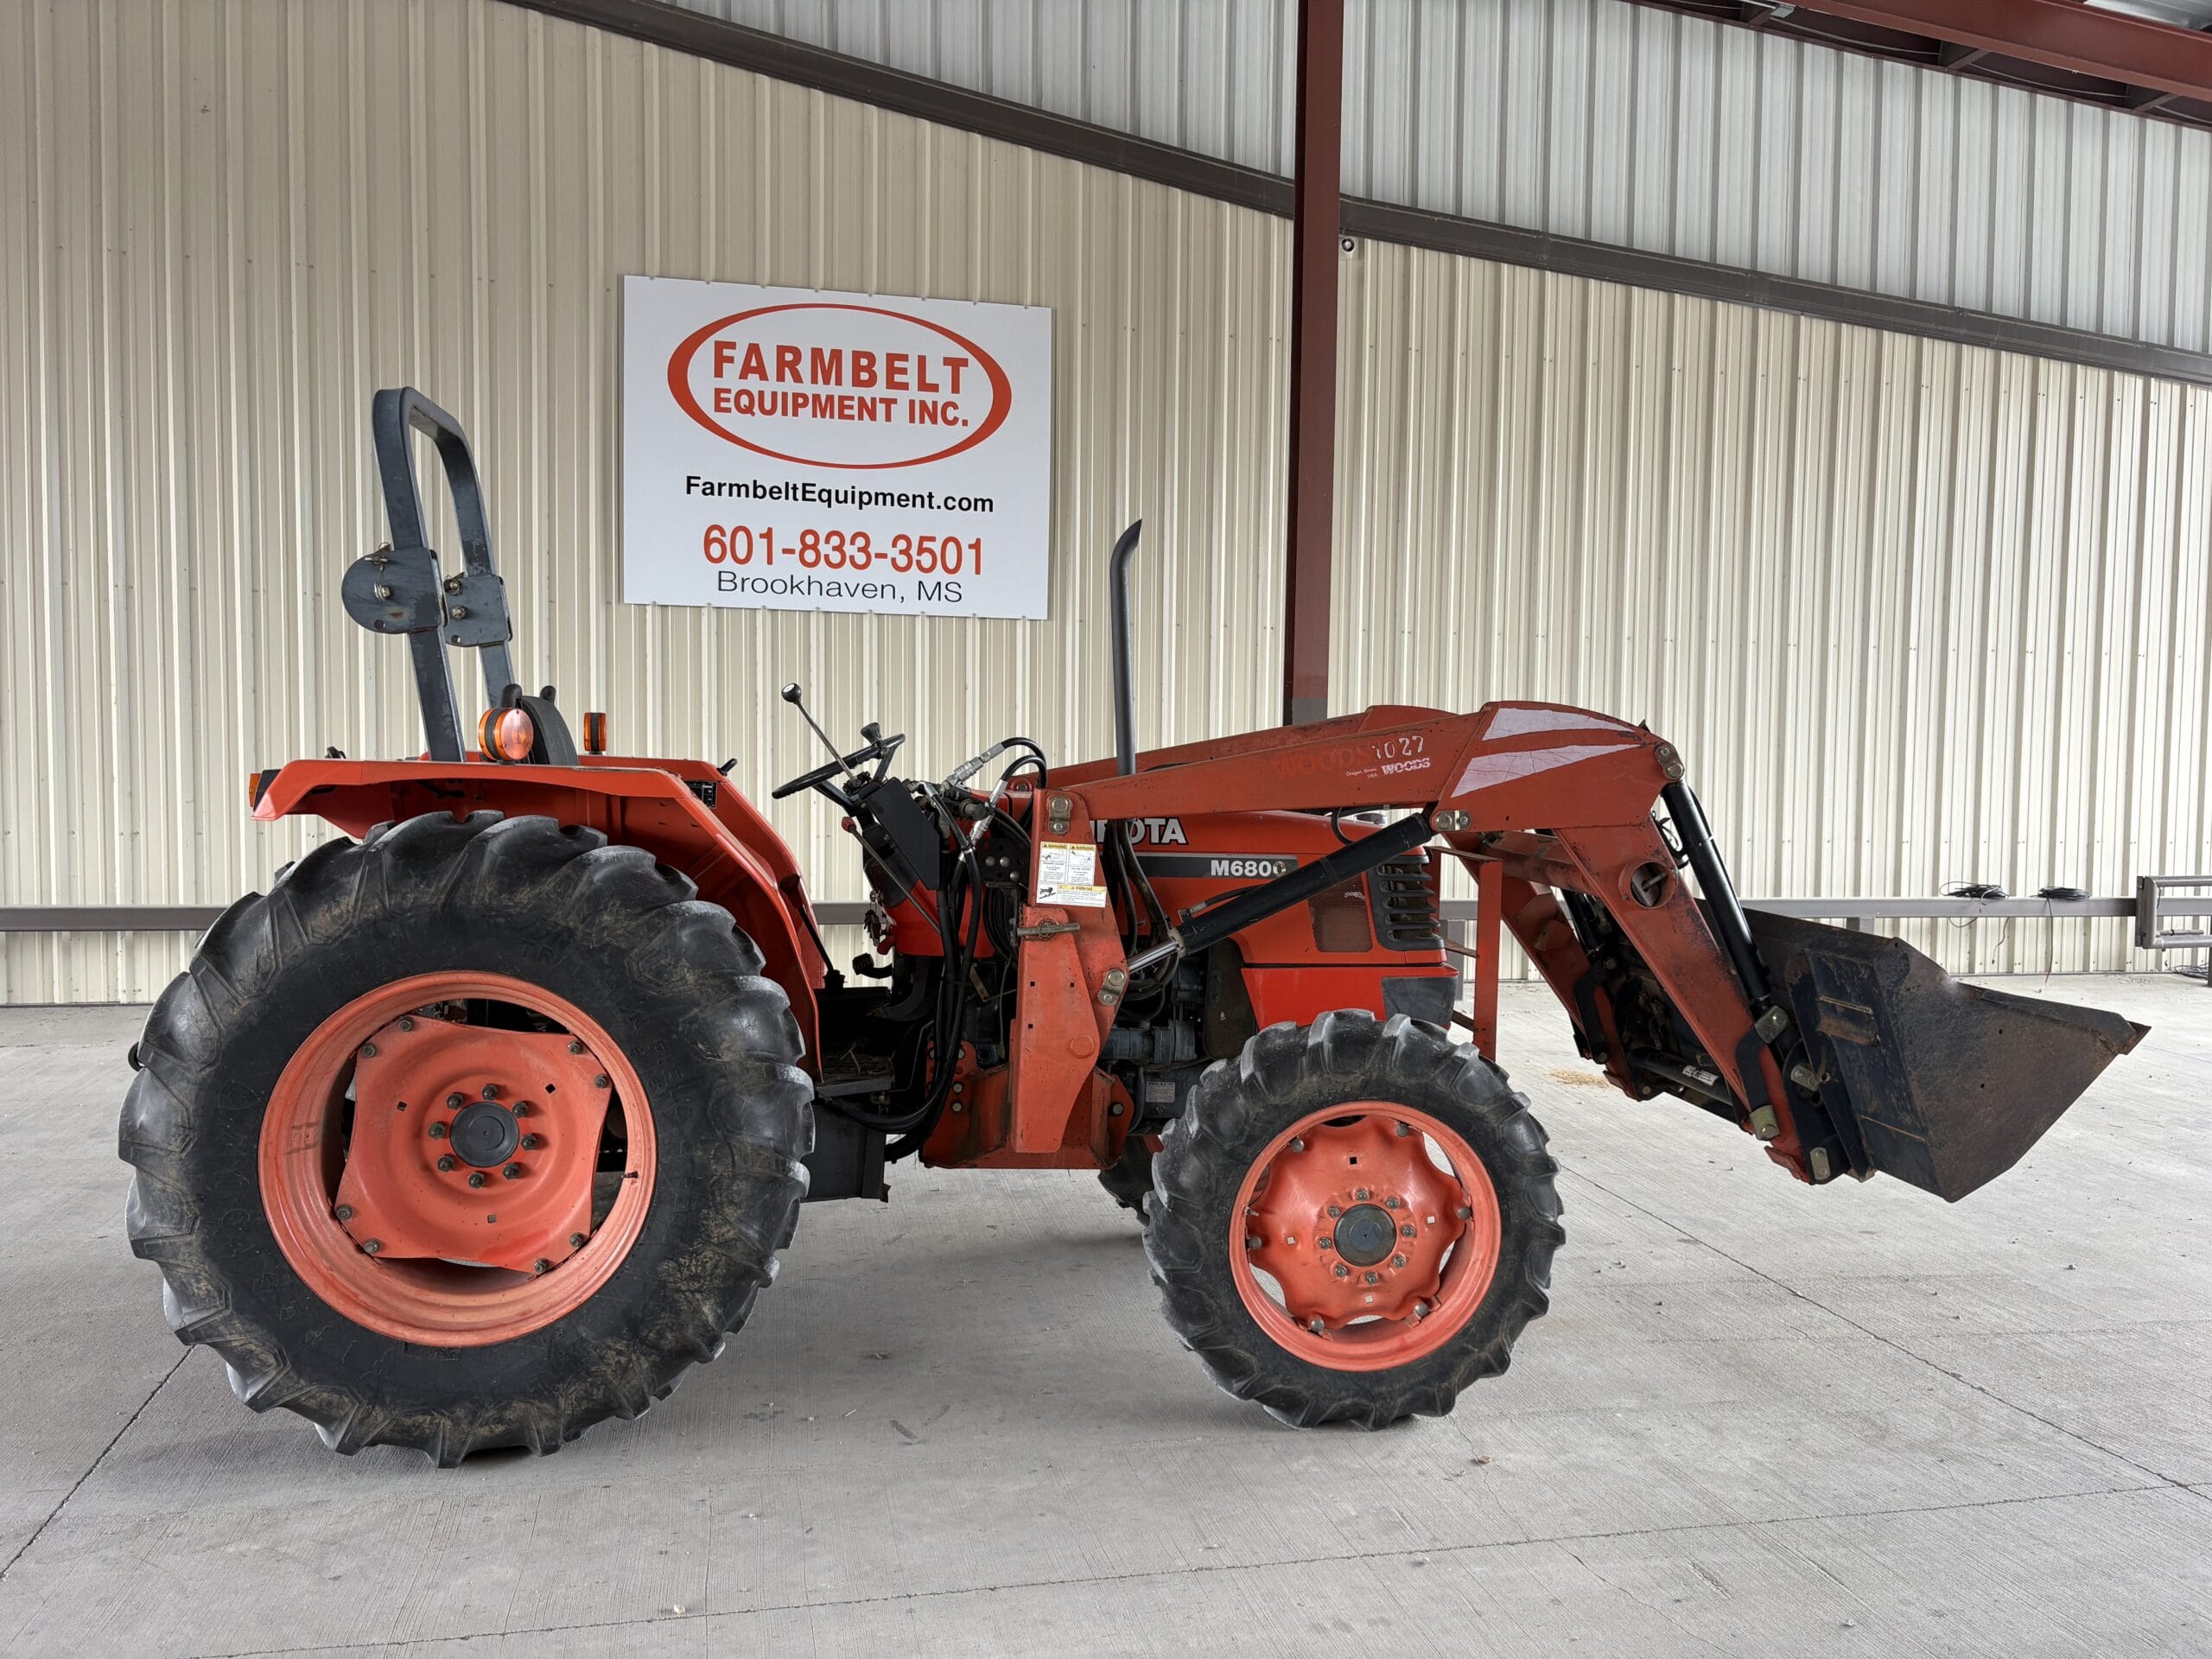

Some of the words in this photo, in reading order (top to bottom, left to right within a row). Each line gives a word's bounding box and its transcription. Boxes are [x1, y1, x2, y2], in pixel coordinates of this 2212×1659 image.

[714, 340, 969, 395] FARMBELT
[714, 387, 898, 423] EQUIPMENT
[908, 399, 969, 427] INC.
[686, 475, 994, 513] FarmbeltEquipment.com
[703, 524, 982, 575] 601-833-3501
[718, 570, 905, 603] Brookhaven,
[918, 581, 963, 603] MS
[1382, 757, 1431, 775] WOODS
[1211, 859, 1287, 878] M6800
